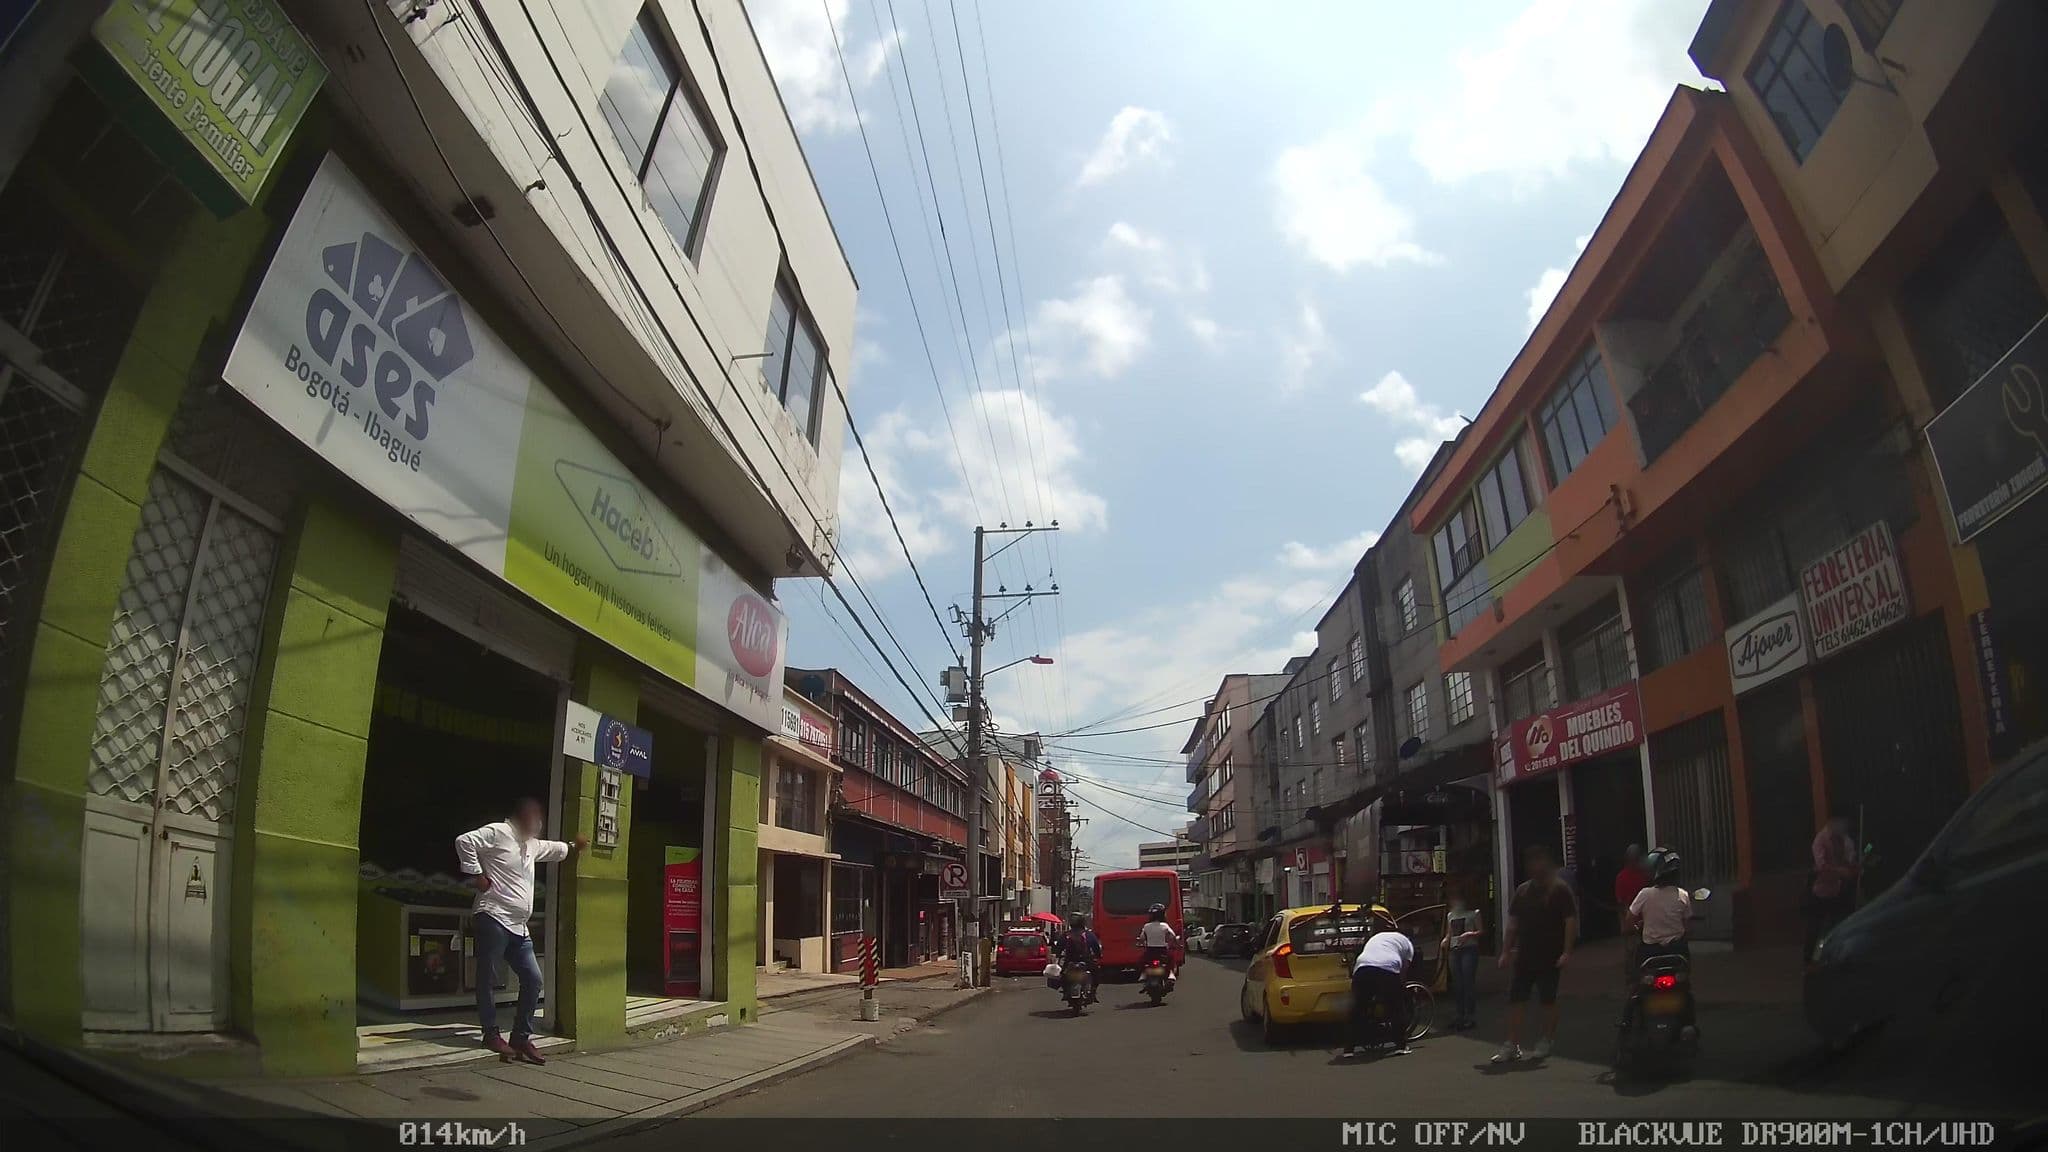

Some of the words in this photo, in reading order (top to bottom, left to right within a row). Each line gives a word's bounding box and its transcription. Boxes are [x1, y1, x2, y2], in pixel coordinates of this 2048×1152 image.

[167, 0, 293, 157] NOGAL
[184, 97, 255, 182] Familiar
[284, 343, 351, 417] Bogotá
[363, 410, 421, 473] Ibagué
[590, 487, 655, 561] Haceb
[544, 541, 561, 569] Un
[562, 552, 592, 593] hogar,
[594, 580, 611, 601] mil
[610, 588, 646, 625] historias
[647, 611, 672, 642] felices
[1802, 523, 1891, 603] FERRETERIA
[732, 603, 771, 663] Alca
[1810, 564, 1900, 637] UNIVERSAL
[1738, 622, 1793, 672] Ajover
[1819, 634, 1840, 653] TELS
[629, 748, 648, 760] AVAL
[1559, 740, 1581, 762] DEL
[1583, 720, 1635, 756] QUINDÍO
[1566, 702, 1622, 738] MUEBLES
